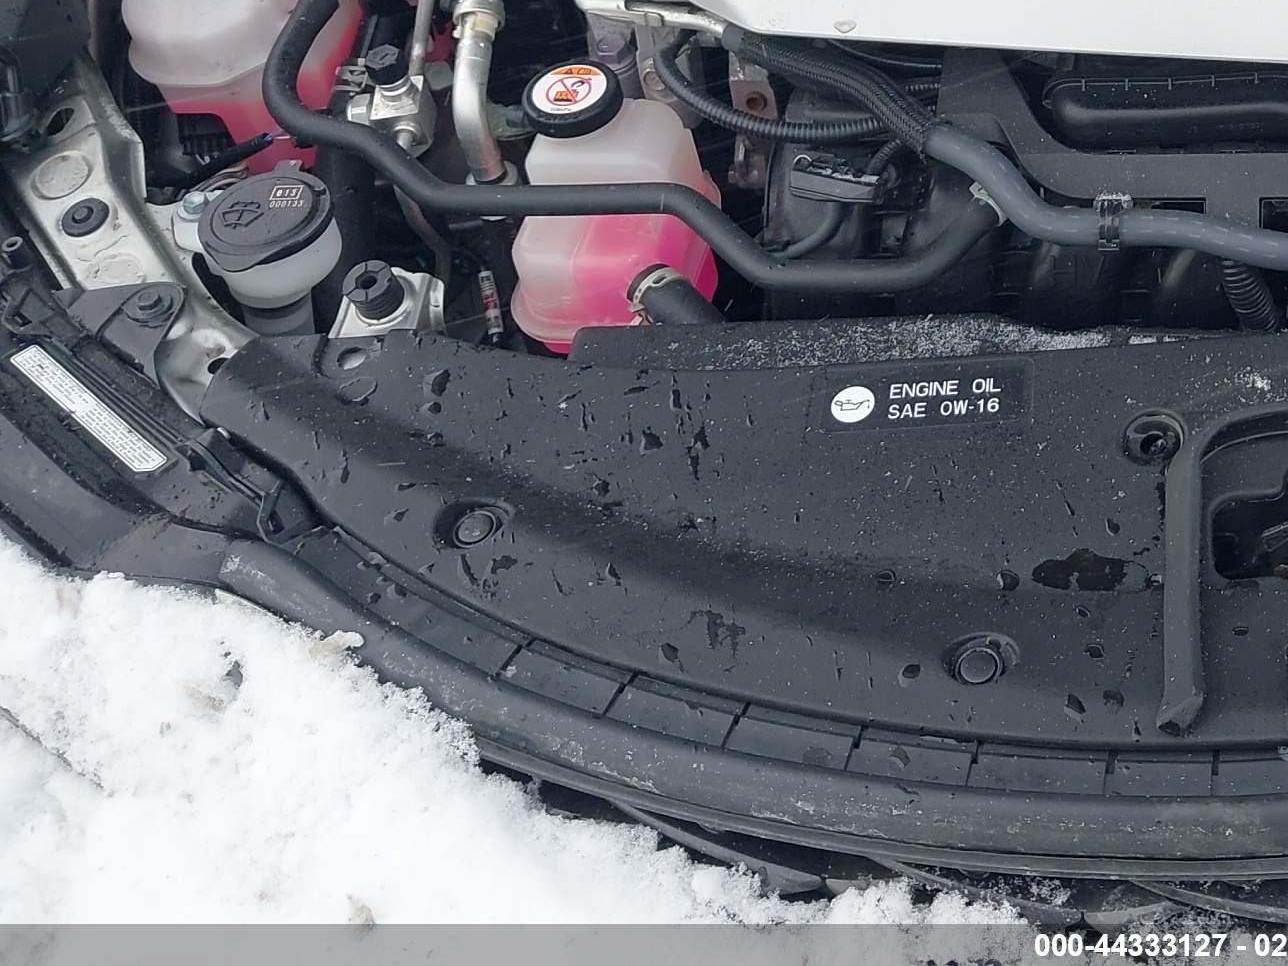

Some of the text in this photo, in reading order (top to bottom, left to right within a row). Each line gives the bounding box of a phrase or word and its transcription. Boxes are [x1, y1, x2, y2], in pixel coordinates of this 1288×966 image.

[889, 377, 1002, 399] ENGINE OIL
[887, 397, 1000, 420] SAE 0W-16
